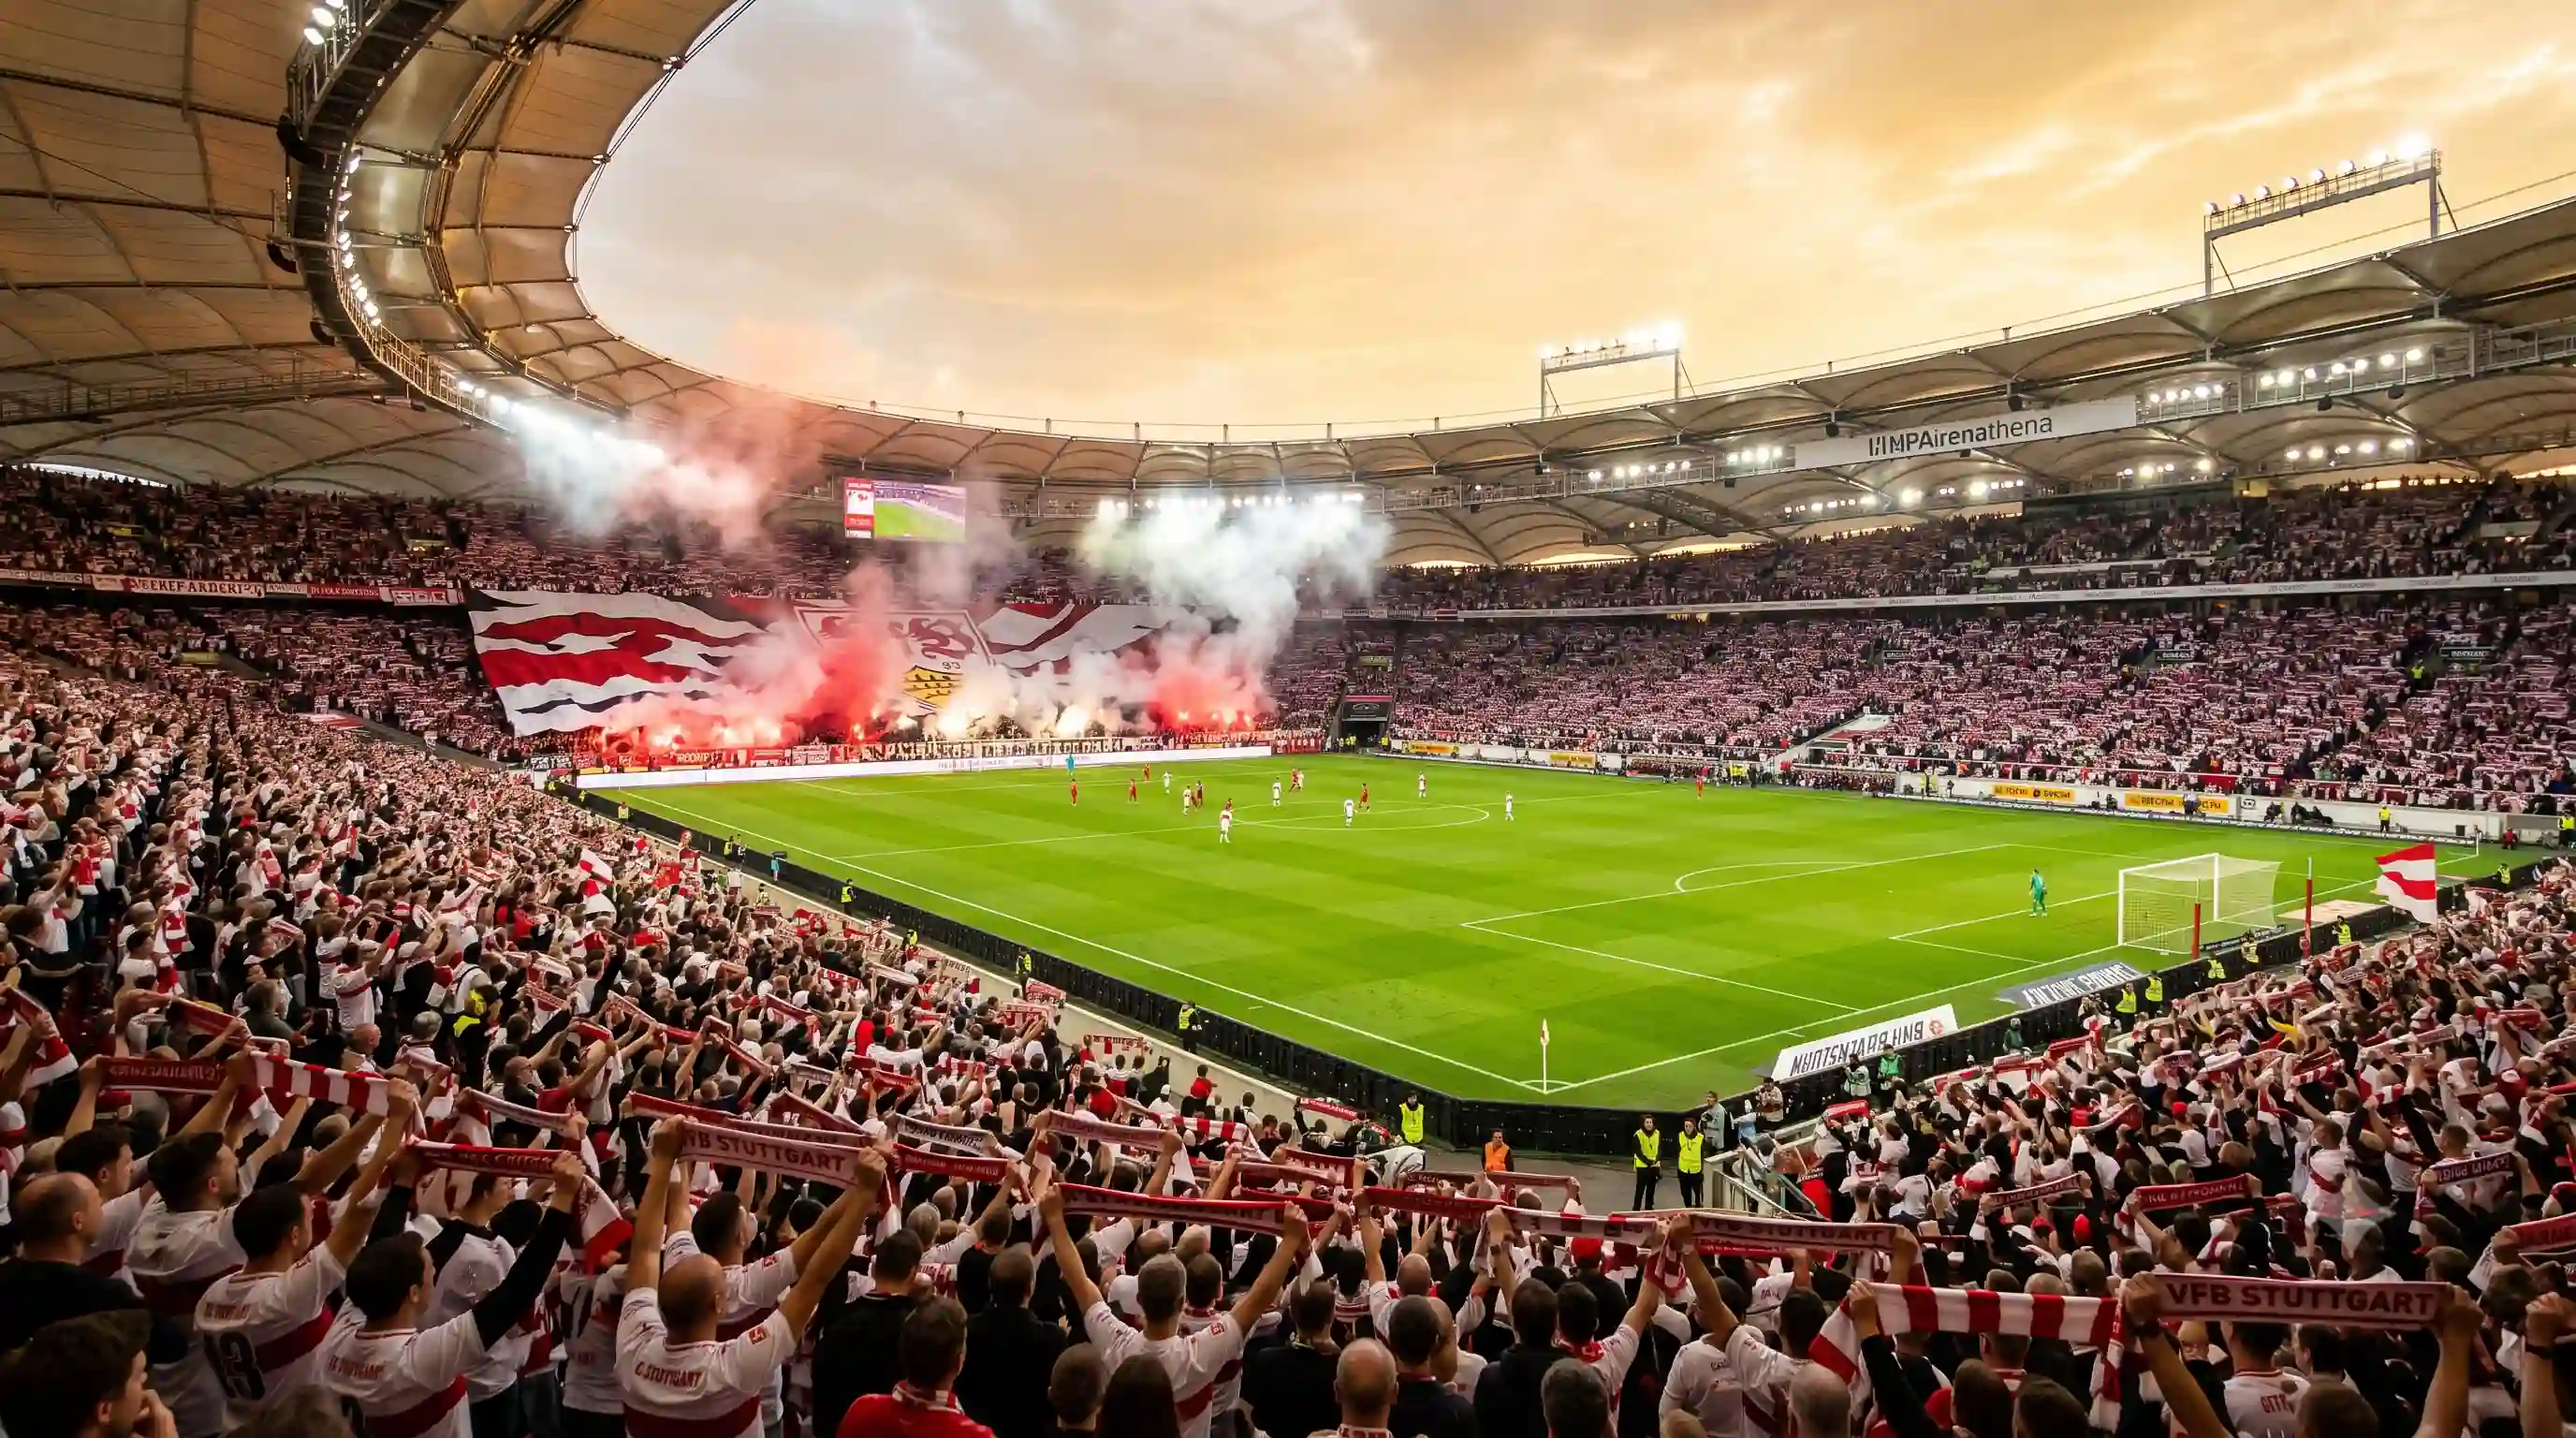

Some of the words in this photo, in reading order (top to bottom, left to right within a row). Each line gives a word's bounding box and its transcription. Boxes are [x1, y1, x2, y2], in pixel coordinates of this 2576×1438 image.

[717, 1136, 845, 1172] STUTTGART
[2166, 1283, 2232, 1306] VFB
[2241, 1285, 2435, 1315] STUTTGART
